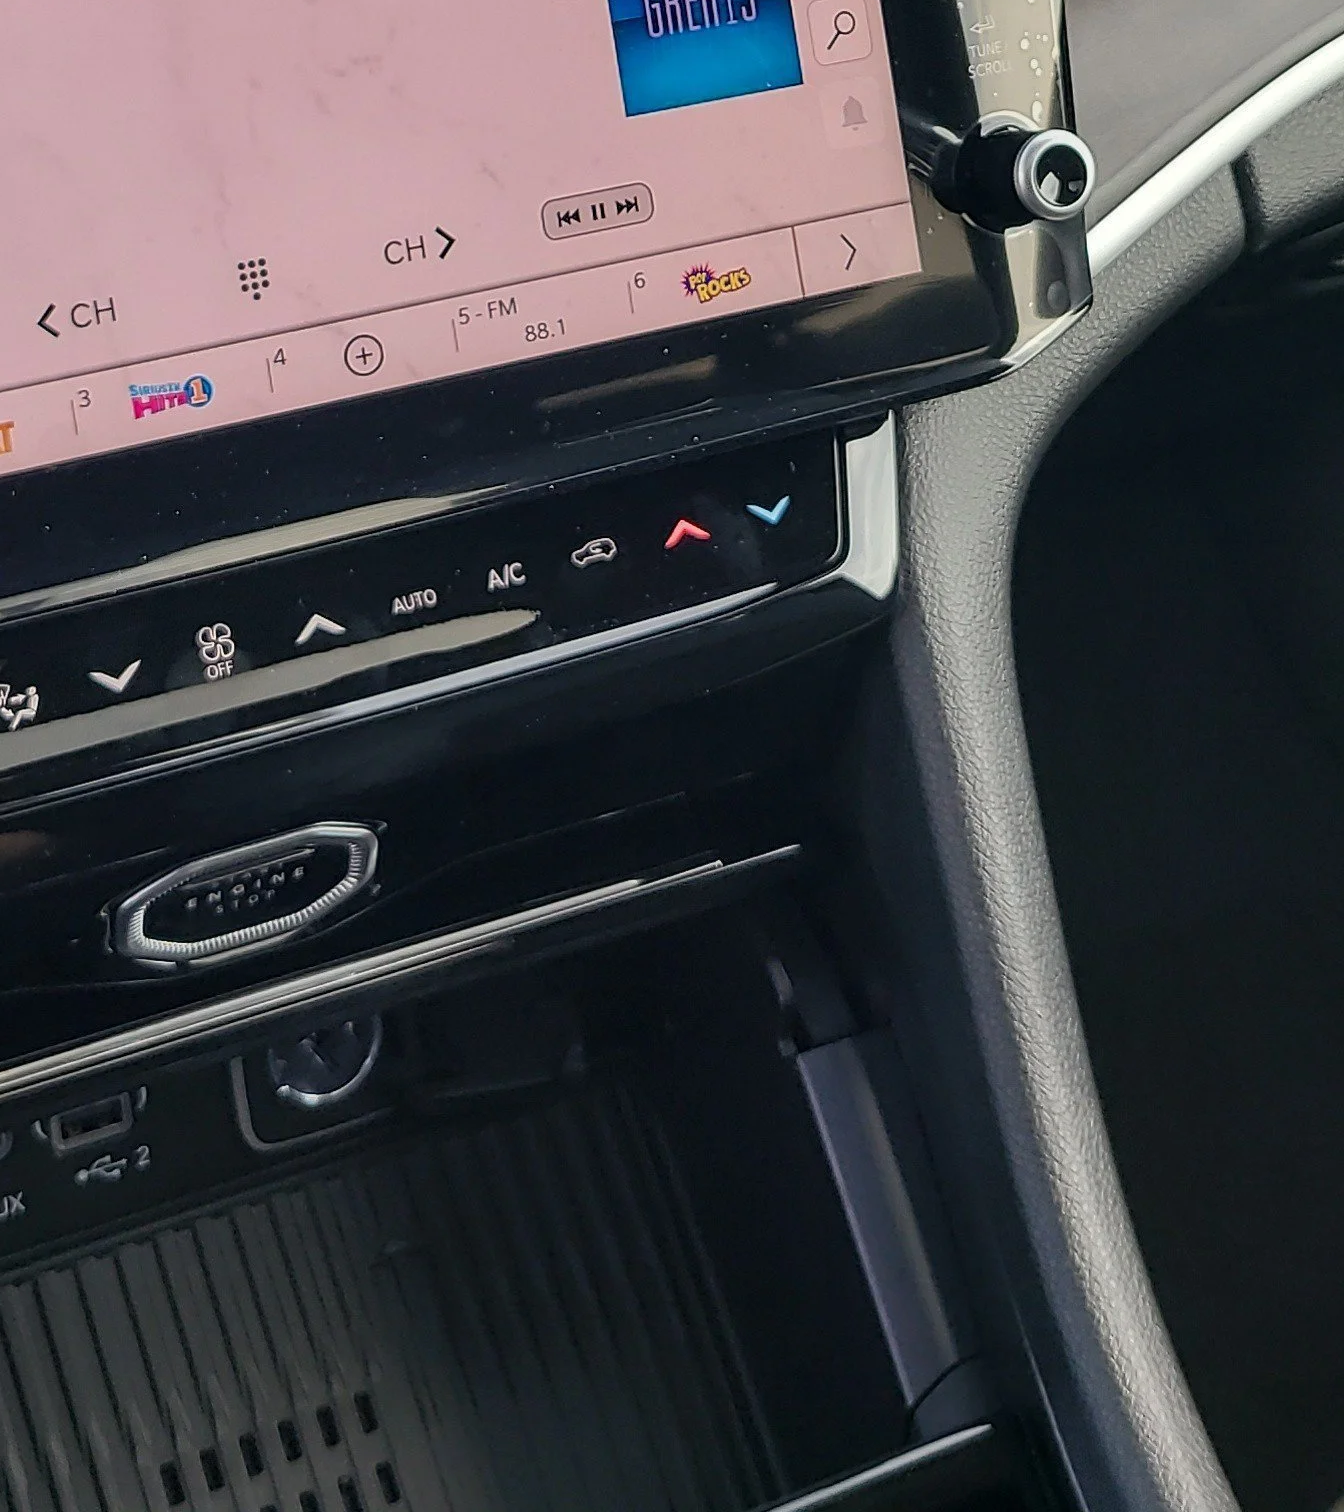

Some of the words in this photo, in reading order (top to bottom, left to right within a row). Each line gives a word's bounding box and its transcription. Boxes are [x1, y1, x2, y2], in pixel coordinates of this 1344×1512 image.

[383, 236, 427, 267] CH
[633, 272, 646, 290] 6
[696, 267, 752, 303] ROCKS
[70, 298, 118, 330] CH
[458, 306, 471, 325] 5
[486, 297, 519, 319] FM
[524, 319, 567, 343] 88.1
[273, 348, 287, 366] 4
[77, 391, 92, 409] 3
[190, 378, 208, 404] 1
[486, 563, 526, 594] A/C
[391, 587, 437, 616] AUTO
[206, 659, 235, 680] OFF
[186, 866, 304, 911] ENGINE
[134, 1145, 151, 1169] 2
